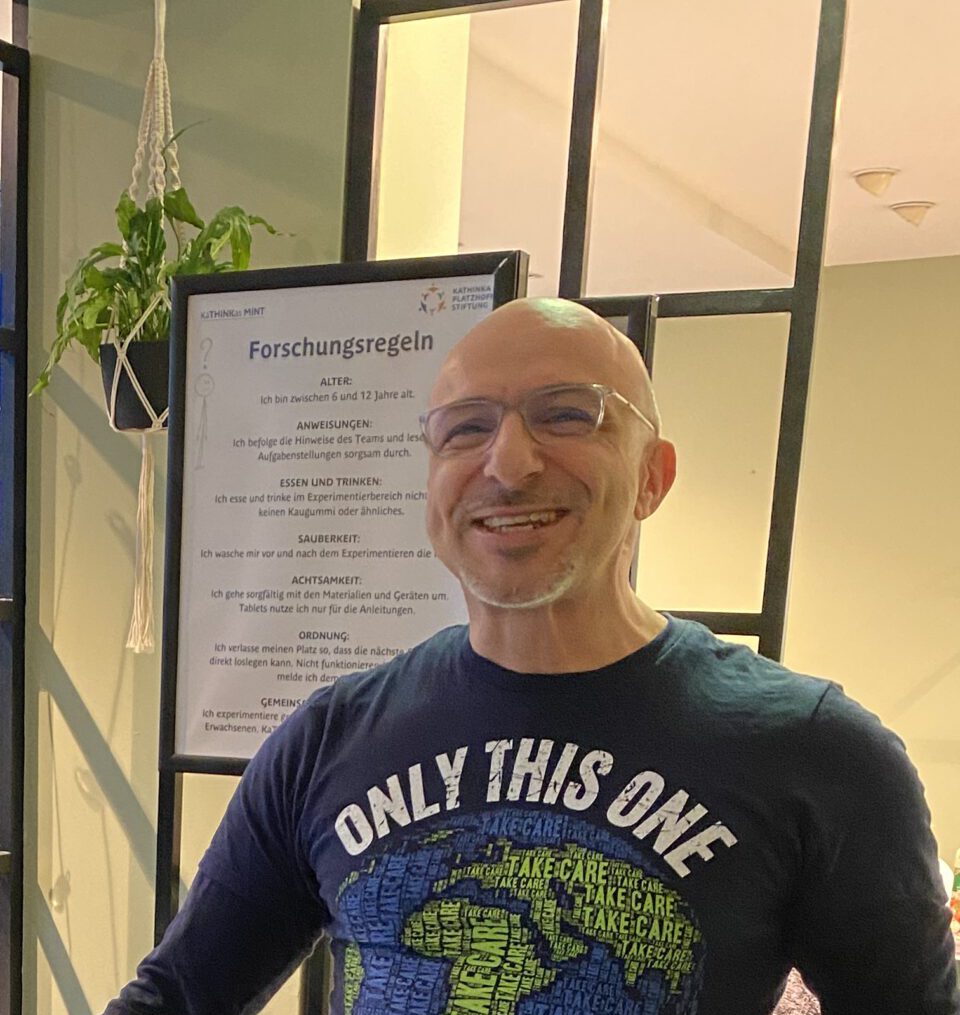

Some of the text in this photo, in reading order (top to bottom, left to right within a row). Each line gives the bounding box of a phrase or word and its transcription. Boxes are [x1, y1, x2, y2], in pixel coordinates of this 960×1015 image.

[452, 286, 491, 294] KATHINKA
[452, 302, 488, 311] STIFTUNG
[249, 330, 434, 361] Forschungsregeln
[320, 377, 352, 386] ALTER:
[260, 389, 415, 405] Ich bin zwischen 6 und 12 Jahre alt.
[296, 419, 373, 431] ANWEISUNGEN:
[233, 438, 245, 448] Ich
[248, 437, 278, 449] befolge
[279, 436, 292, 446] die
[294, 435, 335, 445] Hinweise
[337, 434, 353, 444] des
[355, 433, 384, 444] Teams
[387, 433, 404, 443] und
[257, 448, 411, 463] Aufgabenstellungen sorgsam durch.
[280, 477, 382, 487] ESSEN UND TRINKEN:
[215, 494, 227, 503] Ich
[229, 495, 247, 504] esse
[249, 493, 265, 503] und
[267, 493, 291, 503] trinke
[293, 493, 305, 502] im
[307, 491, 403, 503] Experimentierbereich
[258, 506, 405, 519] keinen Kaugummi oder ähnliches.
[298, 534, 361, 544] SAUBERKEIT:
[200, 549, 213, 558] Ich
[215, 549, 244, 558] wasche
[246, 549, 259, 558] mir
[276, 549, 293, 558] und
[295, 549, 317, 558] nach
[319, 549, 339, 558] dem
[341, 548, 414, 560] Experimentieren
[416, 548, 432, 558] die
[291, 575, 363, 585] ACHTSAMKEIT:
[211, 589, 449, 602] Ich gehe sorgfältig mit den Materialien und Geräten um.
[239, 603, 268, 613] Tablets
[269, 604, 294, 613] nutze
[296, 604, 310, 613] ich
[329, 604, 342, 616] für
[343, 604, 357, 614] die
[360, 604, 416, 616] Anleitungen.
[298, 631, 350, 642] ORDNUNG:
[215, 643, 227, 652] Ich
[228, 643, 260, 653] verlasse
[261, 644, 293, 654] meinen
[296, 645, 317, 654] Platz
[319, 647, 331, 656] so,
[333, 645, 352, 655] dass
[354, 645, 368, 655] die
[209, 658, 232, 666] direkt
[234, 658, 268, 668] loslegen
[270, 659, 293, 668] kann.
[296, 659, 319, 668] Nicht
[277, 672, 303, 682] melde
[305, 673, 318, 682] ich
[202, 709, 214, 718] Ich
[216, 710, 279, 721] experimentiere
[205, 723, 259, 733] Erwachsenen.
[334, 737, 738, 878] ONLY THIS ONE
[481, 813, 519, 835] TAKE
[523, 817, 562, 838] CARE
[507, 856, 609, 884] TAKE CARE
[494, 876, 545, 890] TAKE CARE
[617, 877, 664, 893] TAKE CARE
[585, 884, 675, 918] TAKE CARE
[465, 908, 501, 918] TAKE CARE
[440, 900, 463, 957] TAKE CARE
[582, 907, 685, 944] TAKE CARE
[466, 917, 510, 968] CARE
[621, 939, 686, 962] TAKE CARE
[646, 958, 692, 972] TAKE CARE
[495, 944, 529, 1001] TAKE CARE
